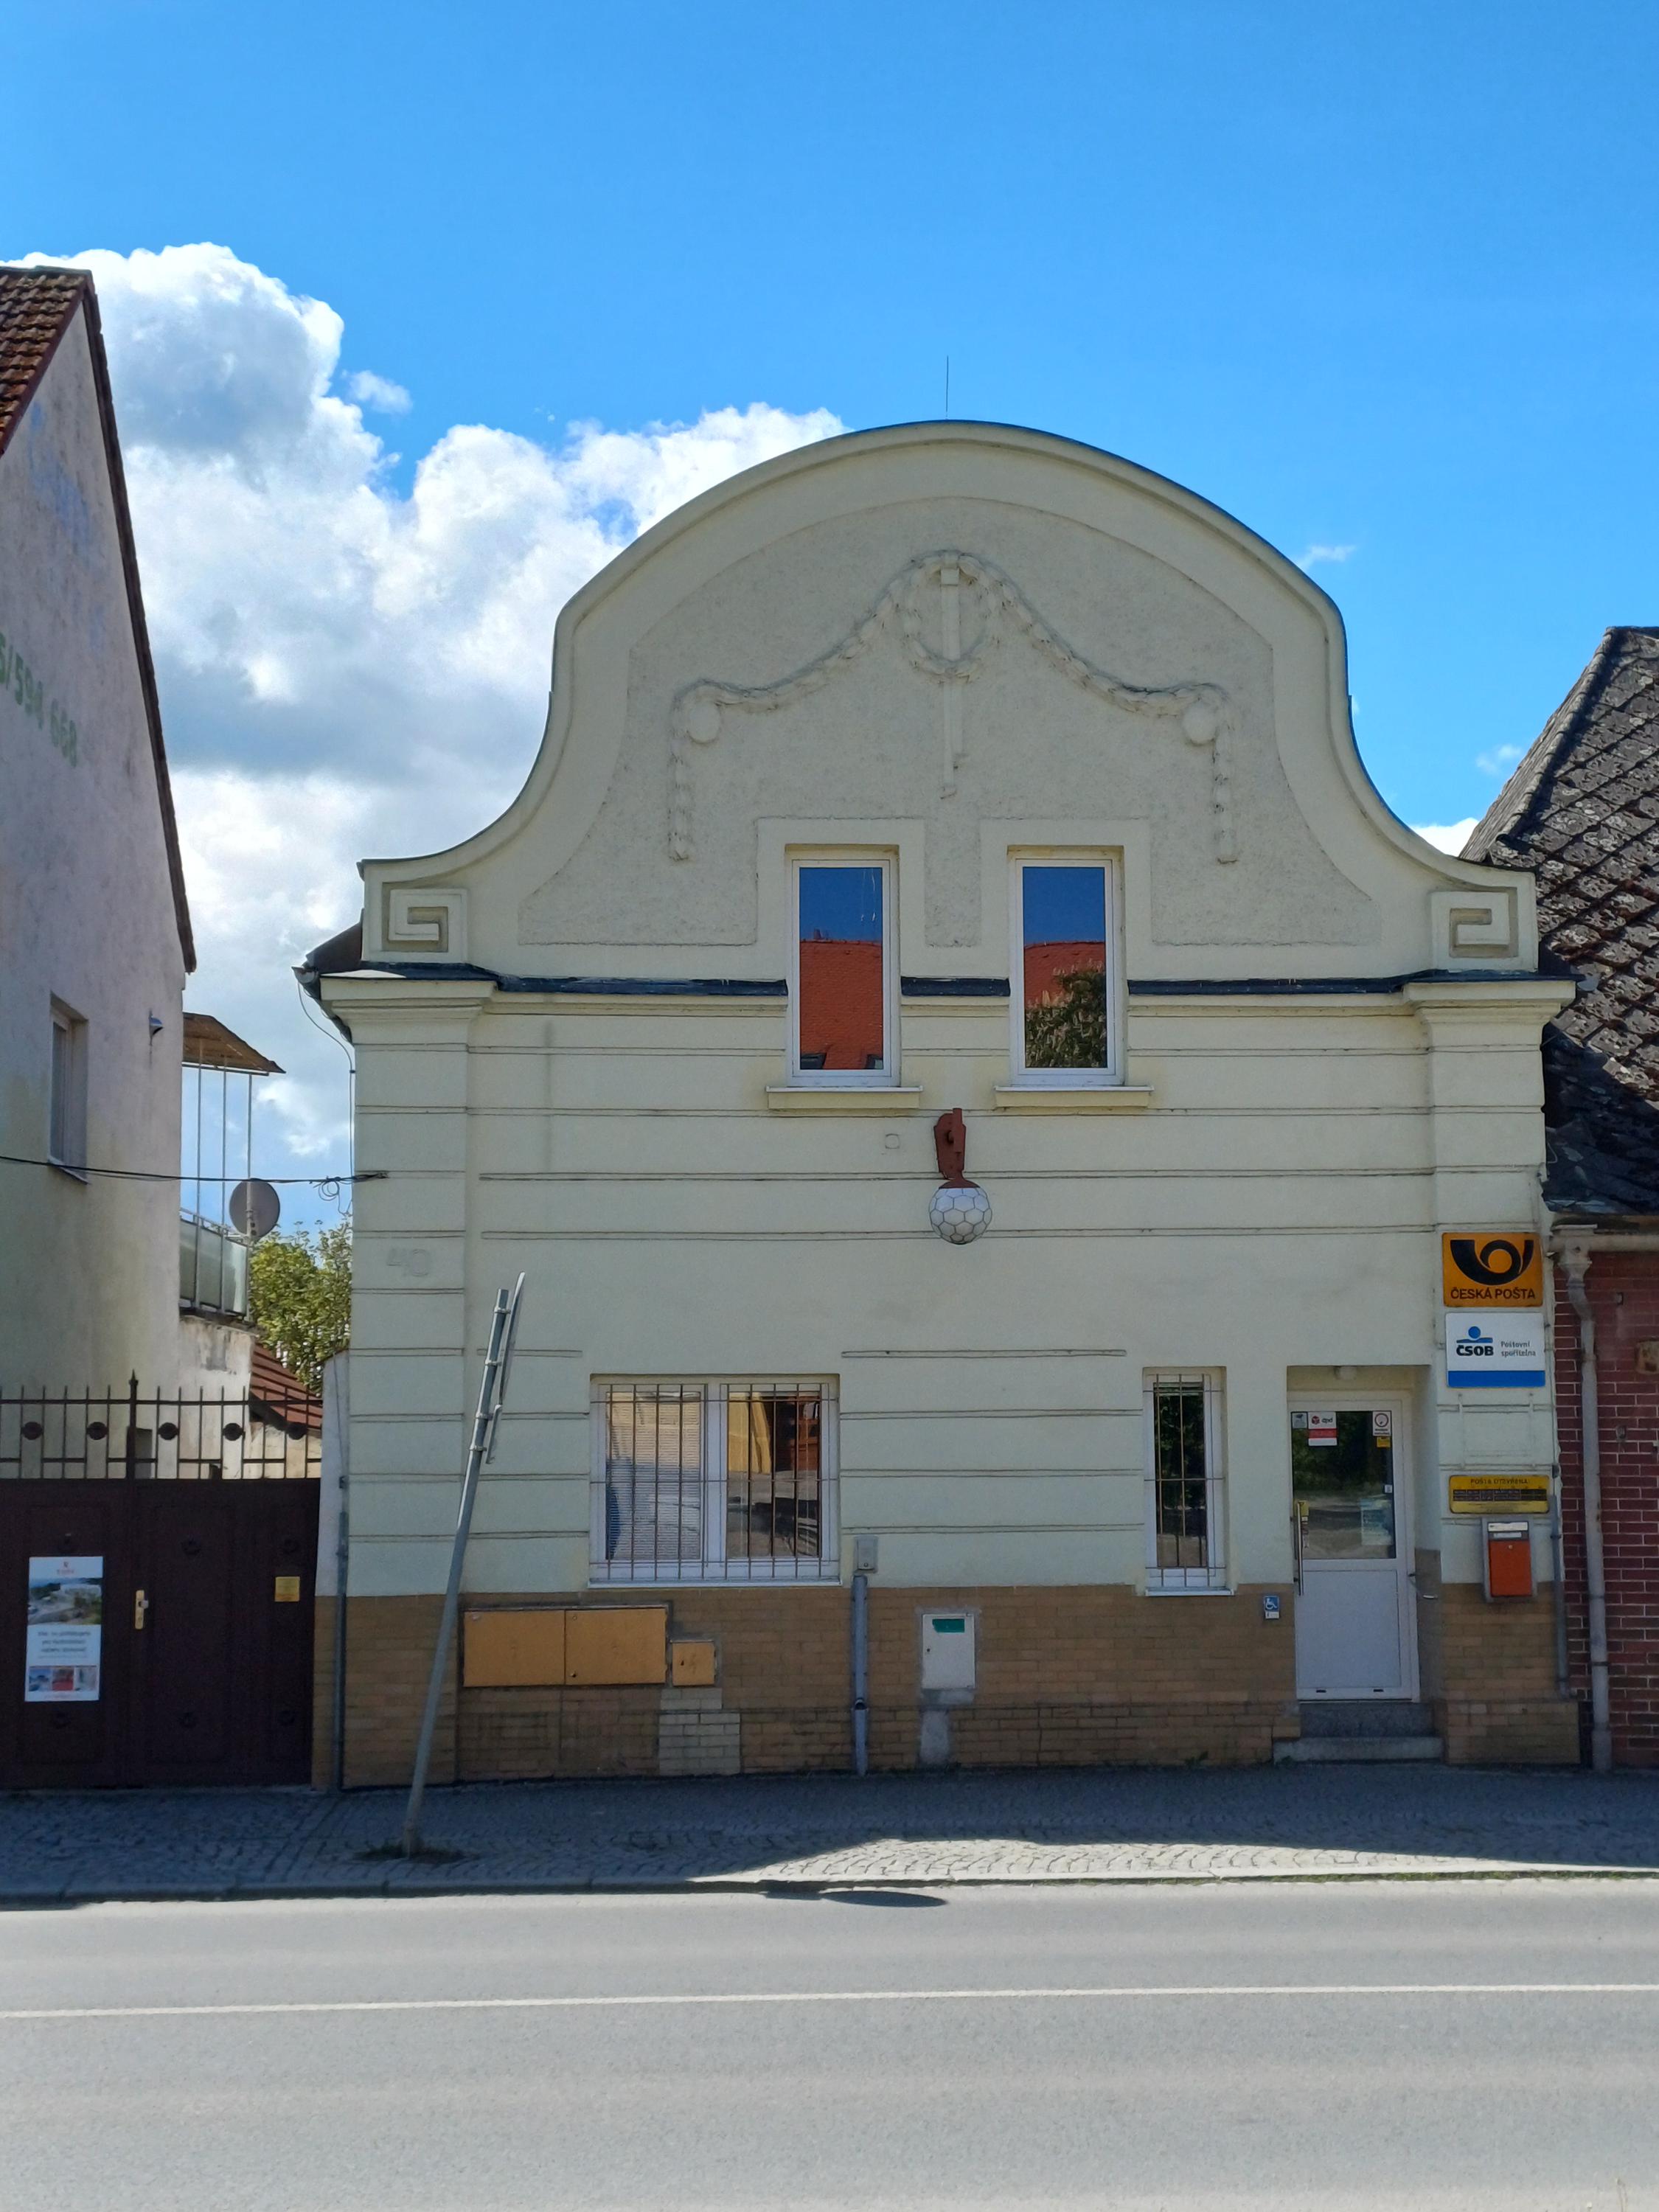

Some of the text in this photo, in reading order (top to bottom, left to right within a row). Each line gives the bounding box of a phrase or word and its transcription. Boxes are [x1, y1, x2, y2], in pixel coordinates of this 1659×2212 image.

[1450, 1287, 1535, 1299] ČESKÁ POŠTA
[1456, 1345, 1494, 1356] ČSOB
[1501, 1349, 1536, 1357] spořitelna
